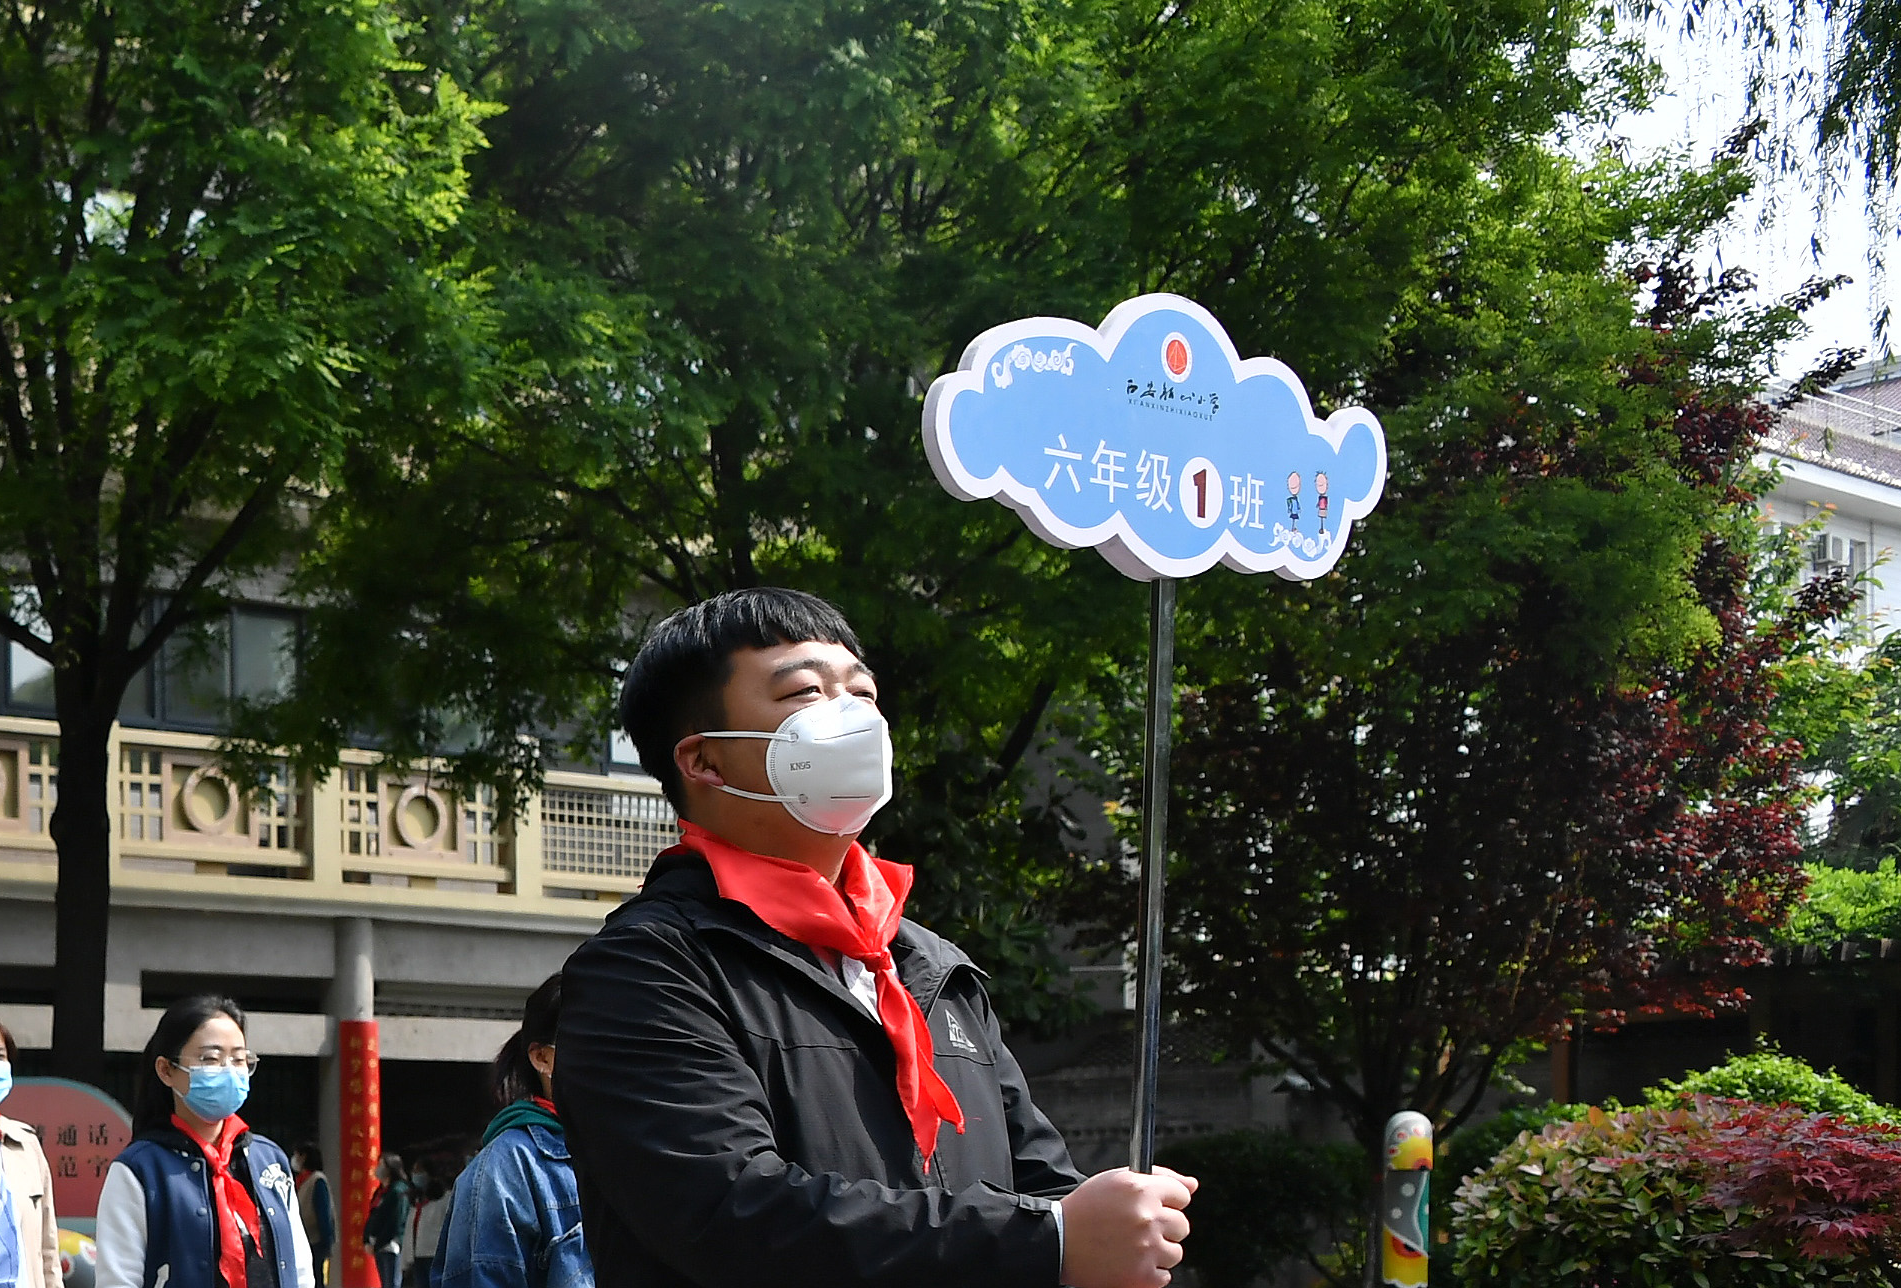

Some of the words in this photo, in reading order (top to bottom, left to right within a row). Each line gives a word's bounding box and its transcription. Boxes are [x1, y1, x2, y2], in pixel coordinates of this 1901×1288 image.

[1043, 433, 1265, 530] 六年级1班
[789, 760, 812, 771] KN95
